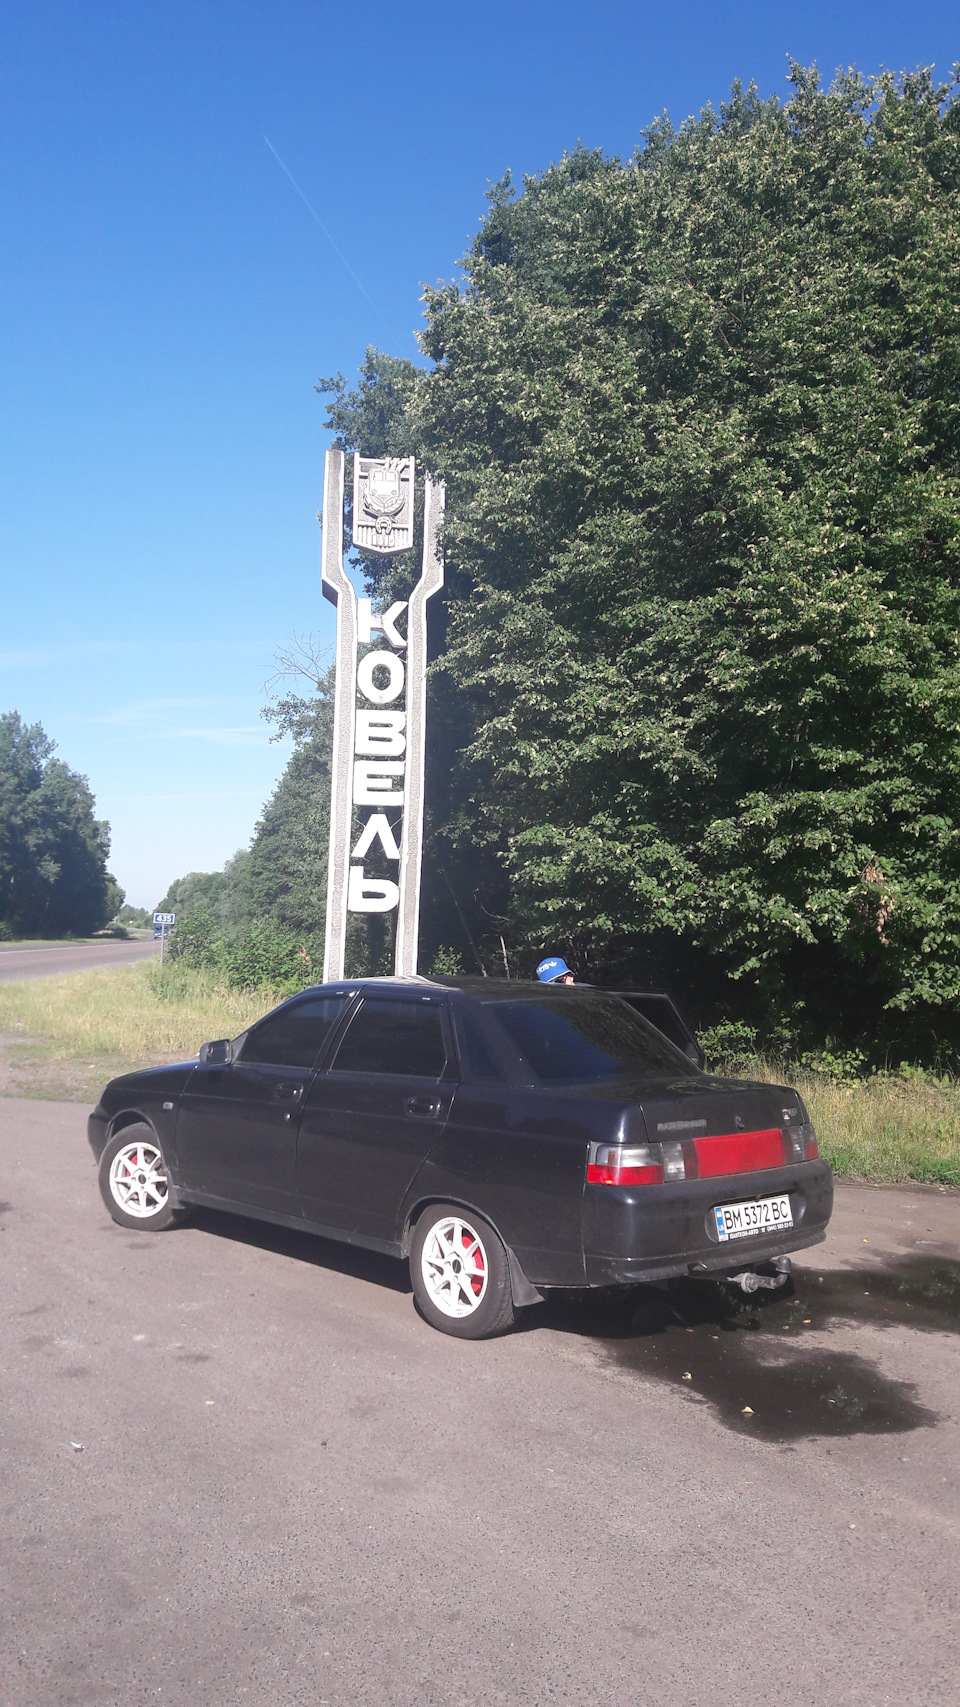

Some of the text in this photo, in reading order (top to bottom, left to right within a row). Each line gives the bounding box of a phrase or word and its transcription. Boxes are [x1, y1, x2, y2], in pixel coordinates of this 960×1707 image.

[372, 534, 395, 547] 1310
[347, 597, 408, 912] КОВЕЛЬ
[156, 914, 172, 922] 435
[724, 1208, 743, 1230] BM
[744, 1204, 770, 1226] 5372
[771, 1200, 788, 1220] BC
